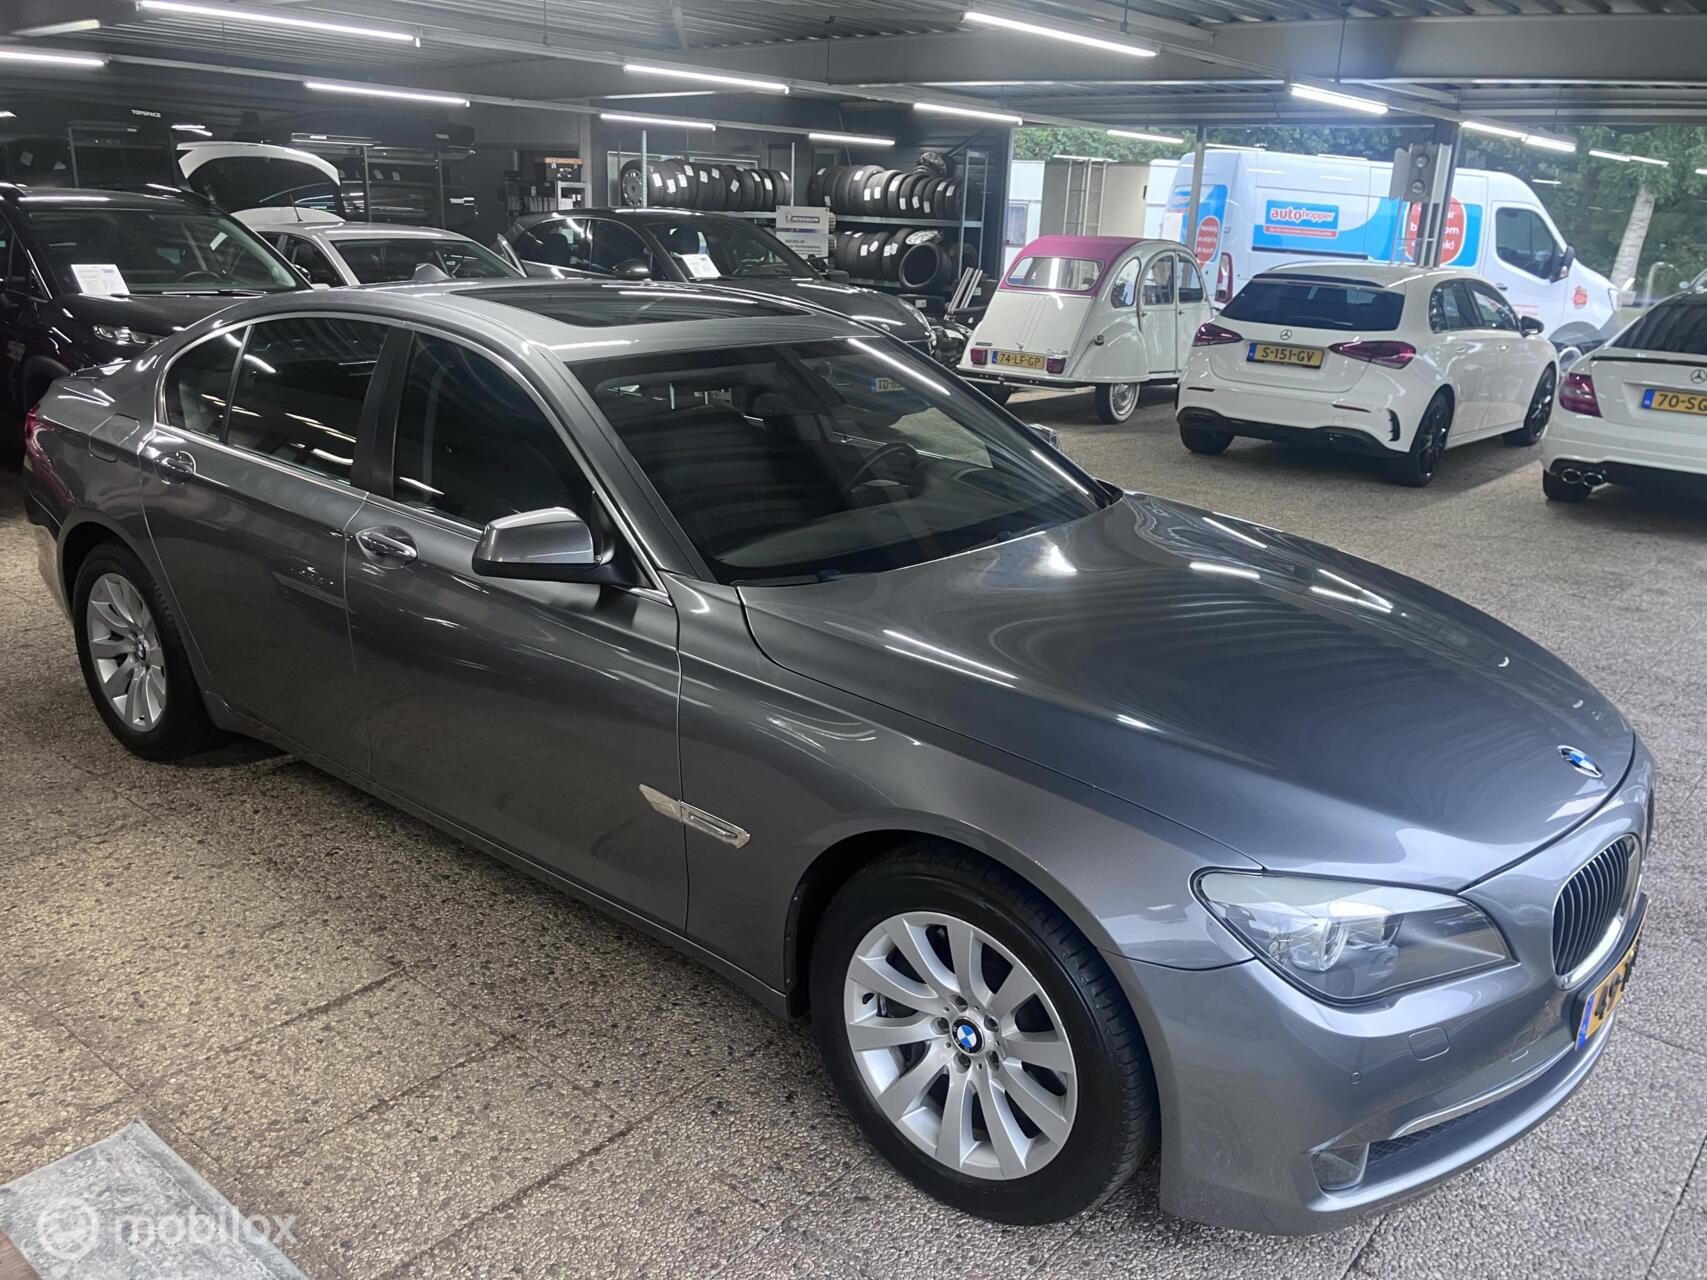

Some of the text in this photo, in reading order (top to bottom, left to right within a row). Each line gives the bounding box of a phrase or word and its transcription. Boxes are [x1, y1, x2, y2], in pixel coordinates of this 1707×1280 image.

[1270, 206, 1336, 223] autohopper
[999, 353, 1041, 367] 74-LF-GP
[1261, 346, 1315, 363] S-151-GV
